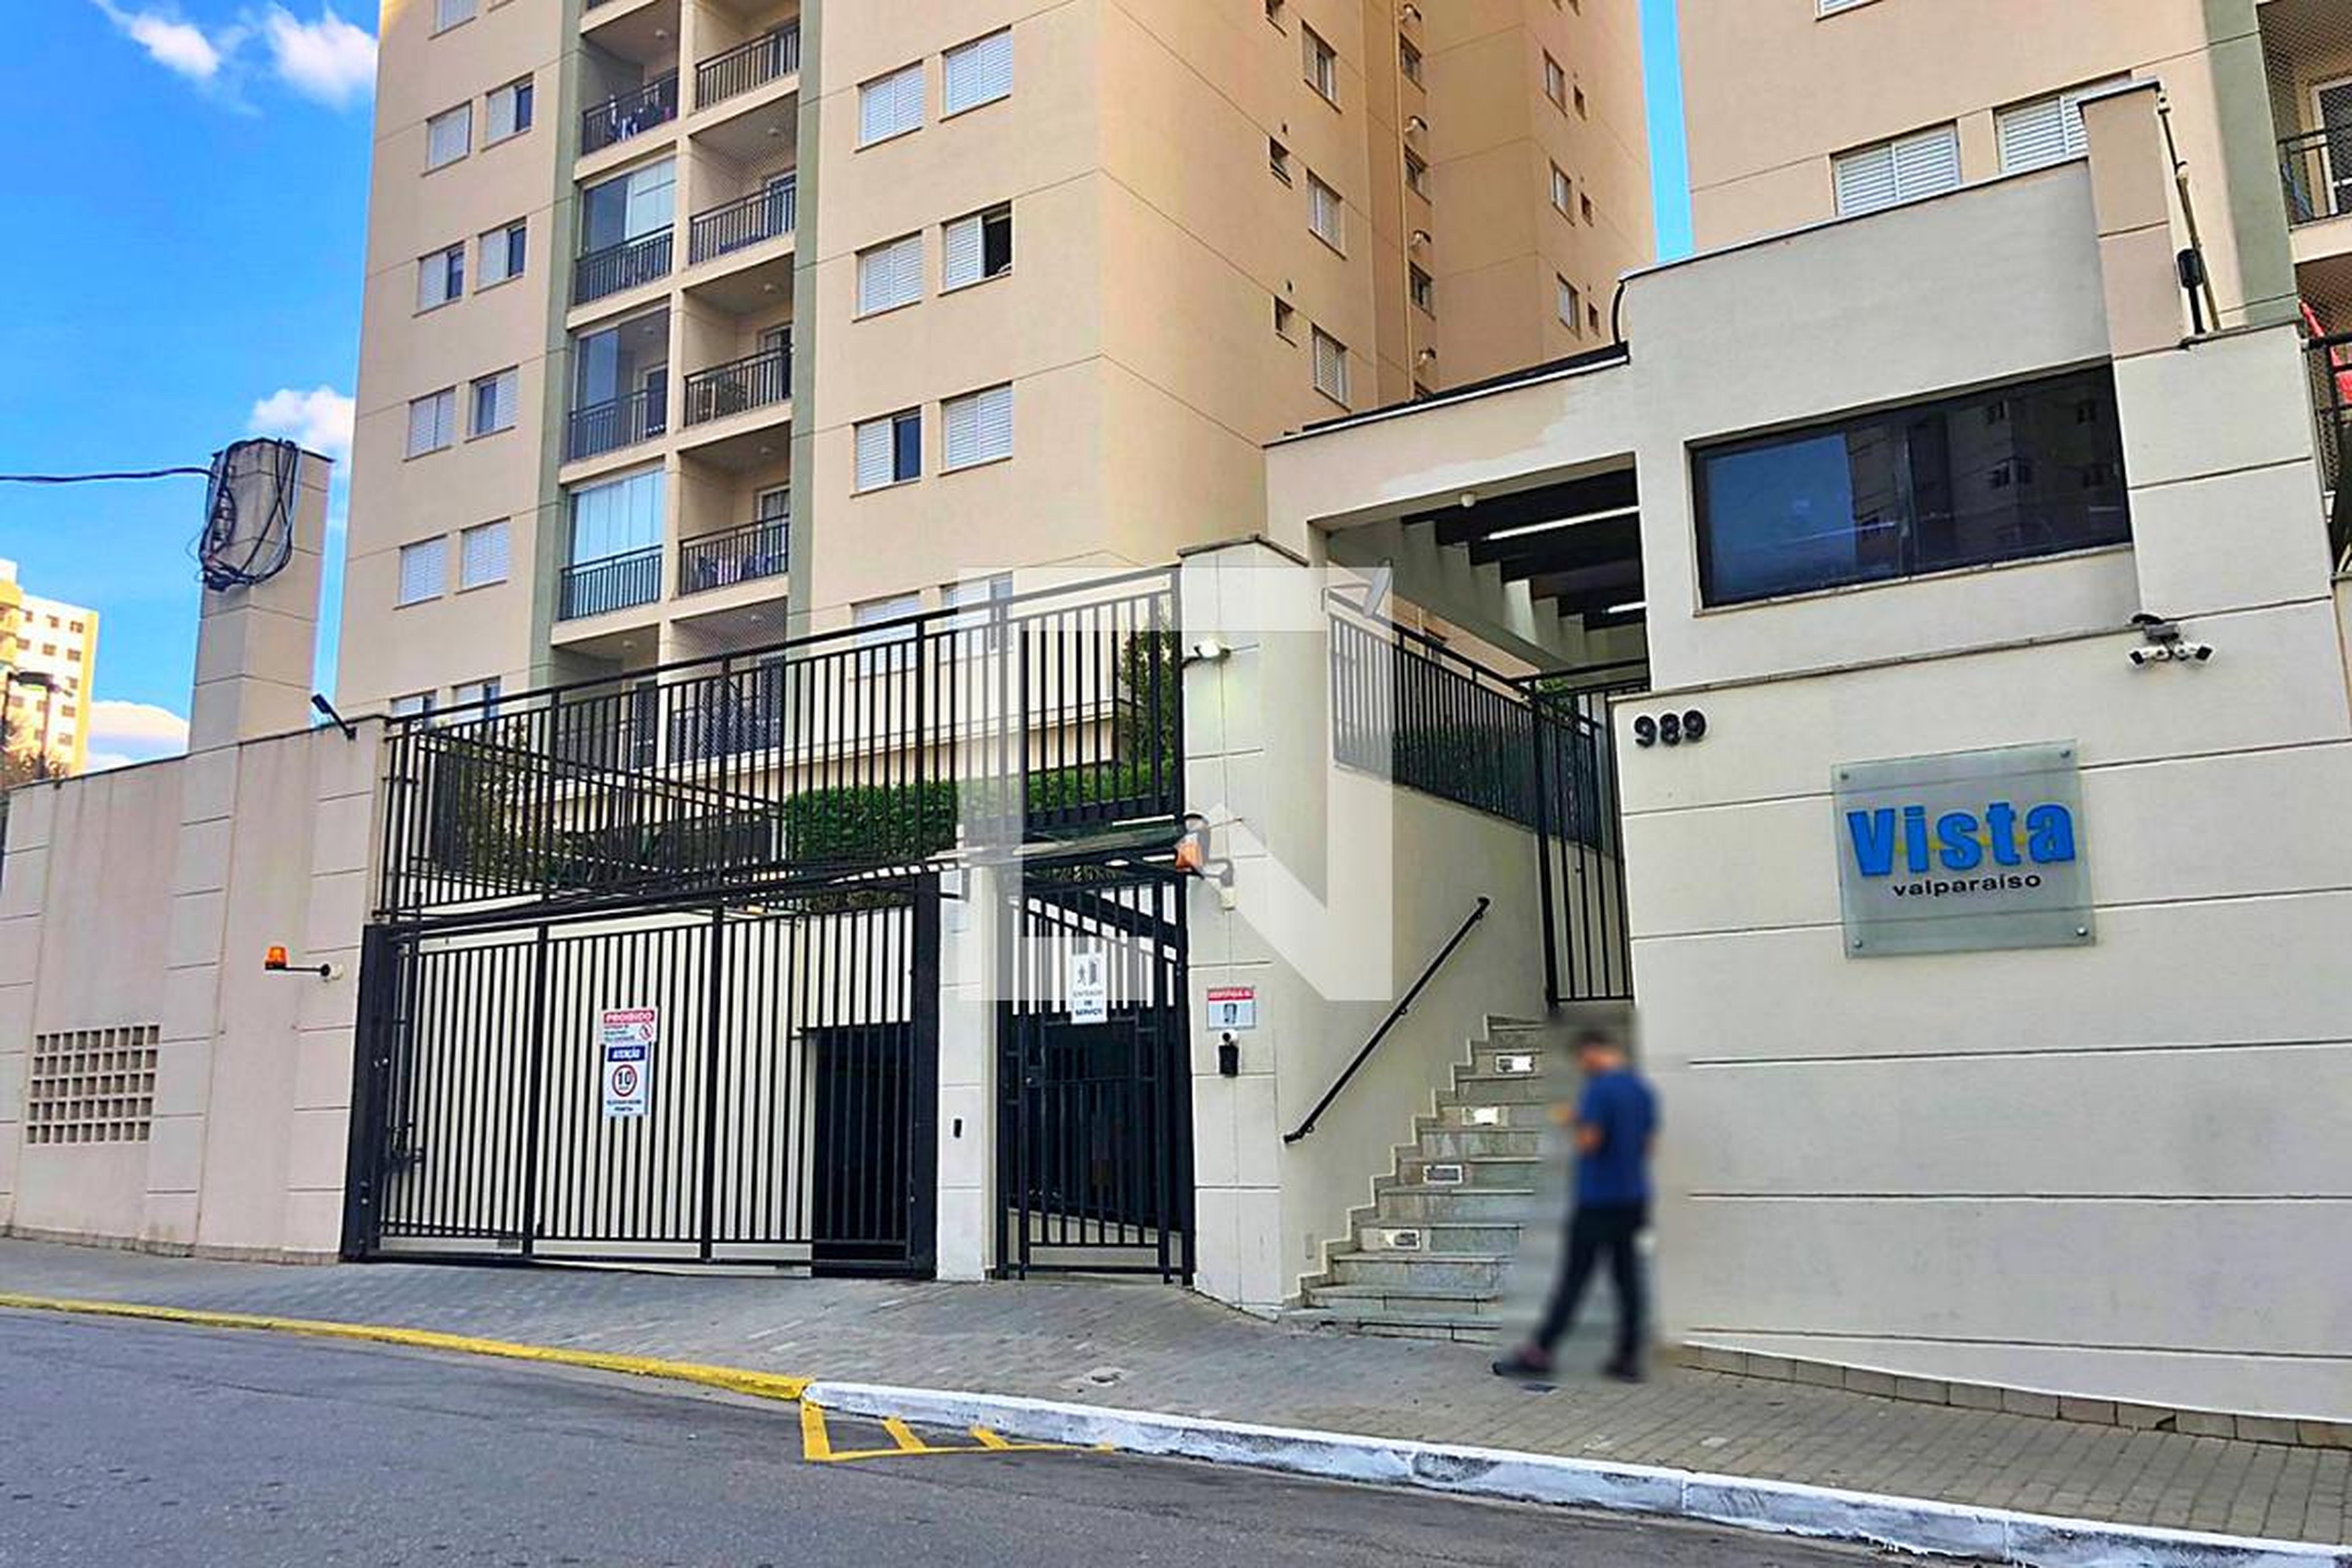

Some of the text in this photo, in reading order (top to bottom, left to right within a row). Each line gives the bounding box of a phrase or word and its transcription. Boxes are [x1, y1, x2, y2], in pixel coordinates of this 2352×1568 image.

[1634, 709, 1707, 748] 989
[1845, 802, 2076, 877] Vista
[618, 1071, 633, 1085] 10
